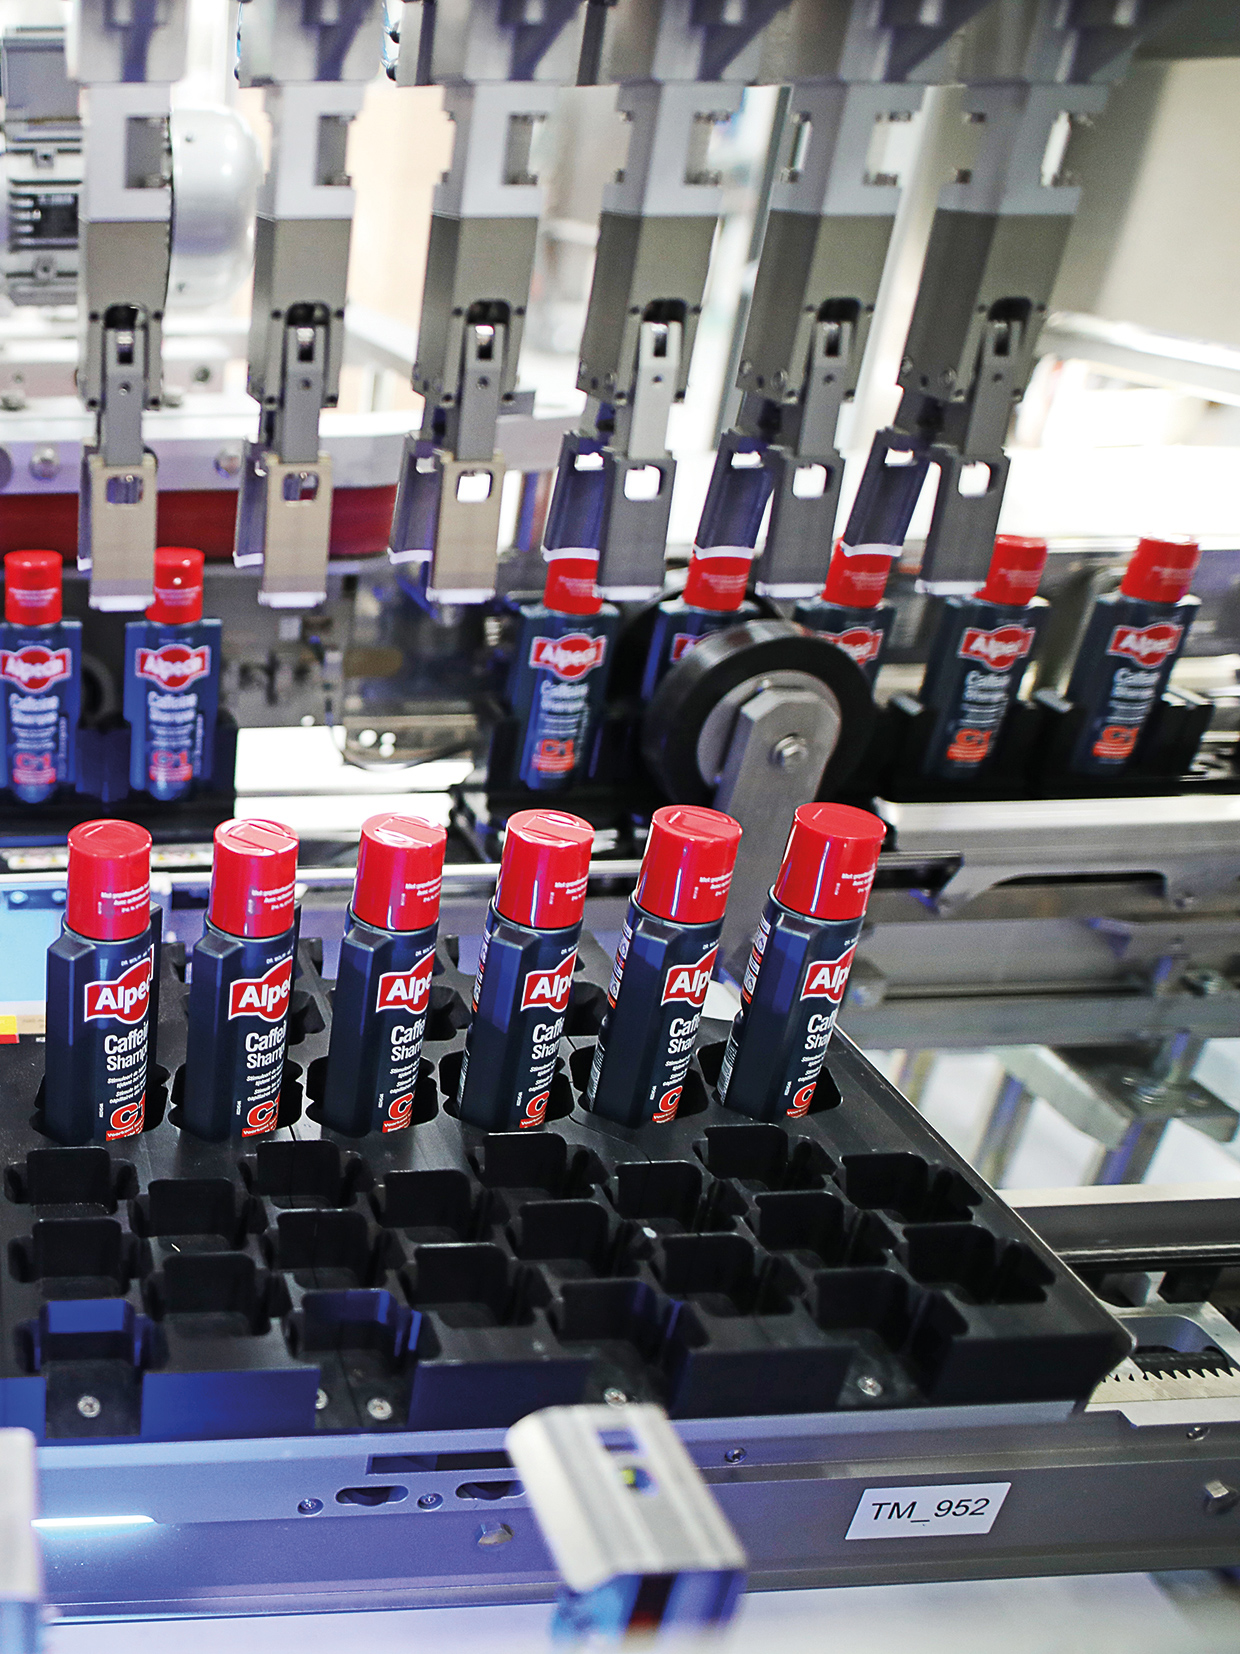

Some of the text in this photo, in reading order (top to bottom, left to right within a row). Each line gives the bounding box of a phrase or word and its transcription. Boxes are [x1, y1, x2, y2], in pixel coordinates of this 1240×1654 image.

[238, 973, 290, 1012] Alpe
[386, 971, 432, 1004] Alpe
[105, 1020, 148, 1055] Caffei
[533, 1017, 564, 1043] Caff
[106, 1042, 148, 1071] Shamp
[388, 1092, 414, 1119] C
[526, 1091, 549, 1117] C
[659, 1086, 683, 1112] C
[793, 1082, 816, 1107] C
[872, 1498, 990, 1523] TM_952
